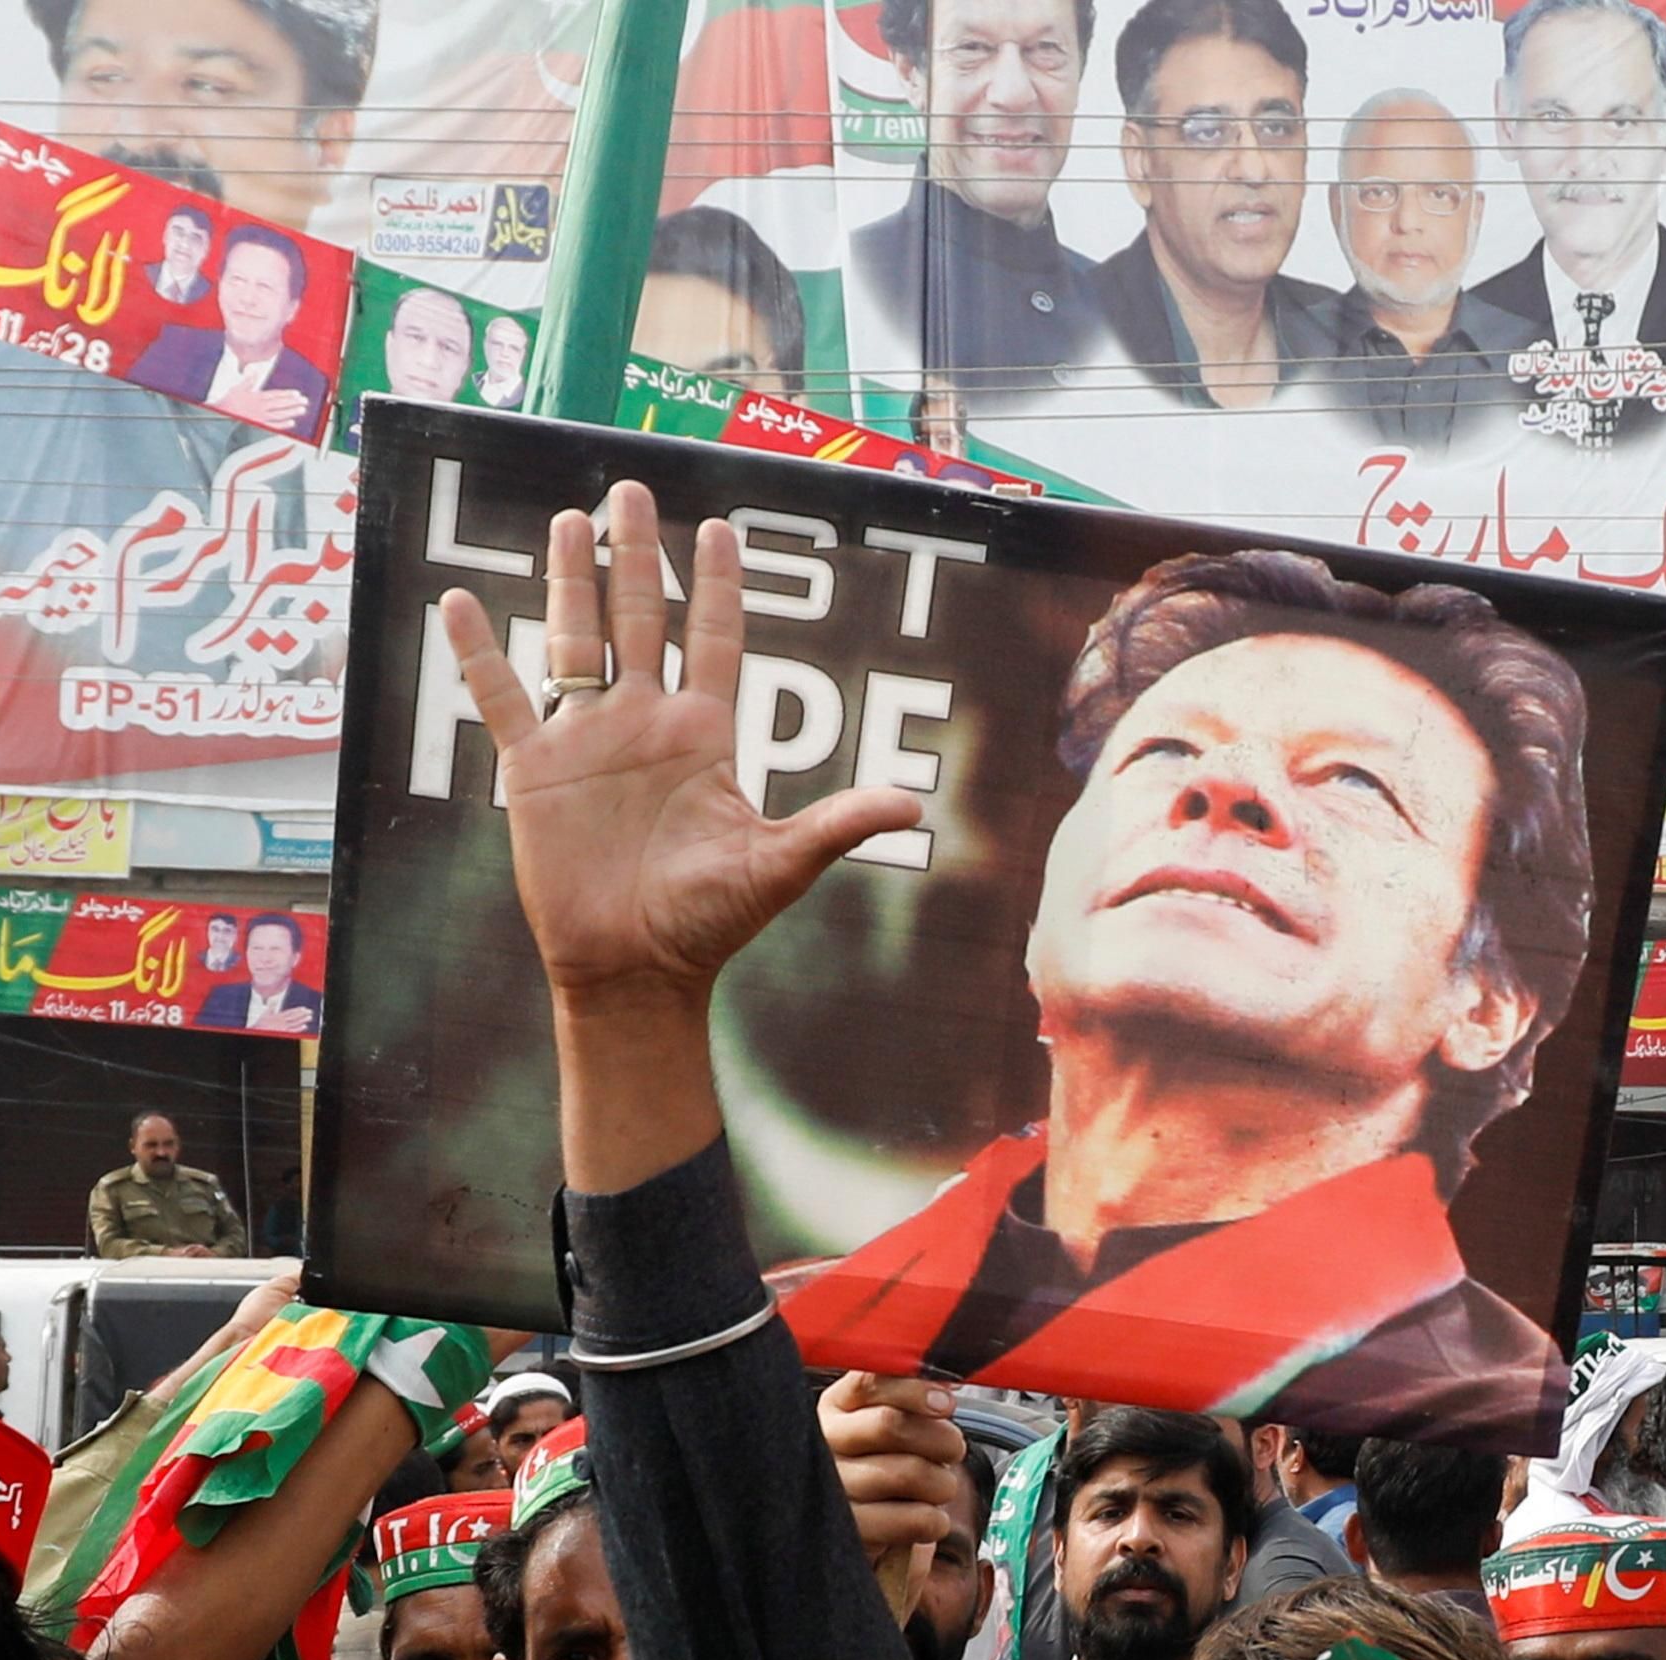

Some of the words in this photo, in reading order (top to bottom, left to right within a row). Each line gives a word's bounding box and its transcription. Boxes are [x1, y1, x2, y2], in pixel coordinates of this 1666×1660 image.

[375, 233, 481, 256] 0300-9554240
[62, 331, 112, 375] 28
[1357, 454, 1572, 572] مارچ
[114, 443, 296, 652] اکرم
[74, 681, 202, 722] PP-51
[32, 904, 188, 999] لانگ
[107, 999, 127, 1022] 11
[150, 1003, 183, 1027] 28
[1501, 1555, 1579, 1603] پاکستان
